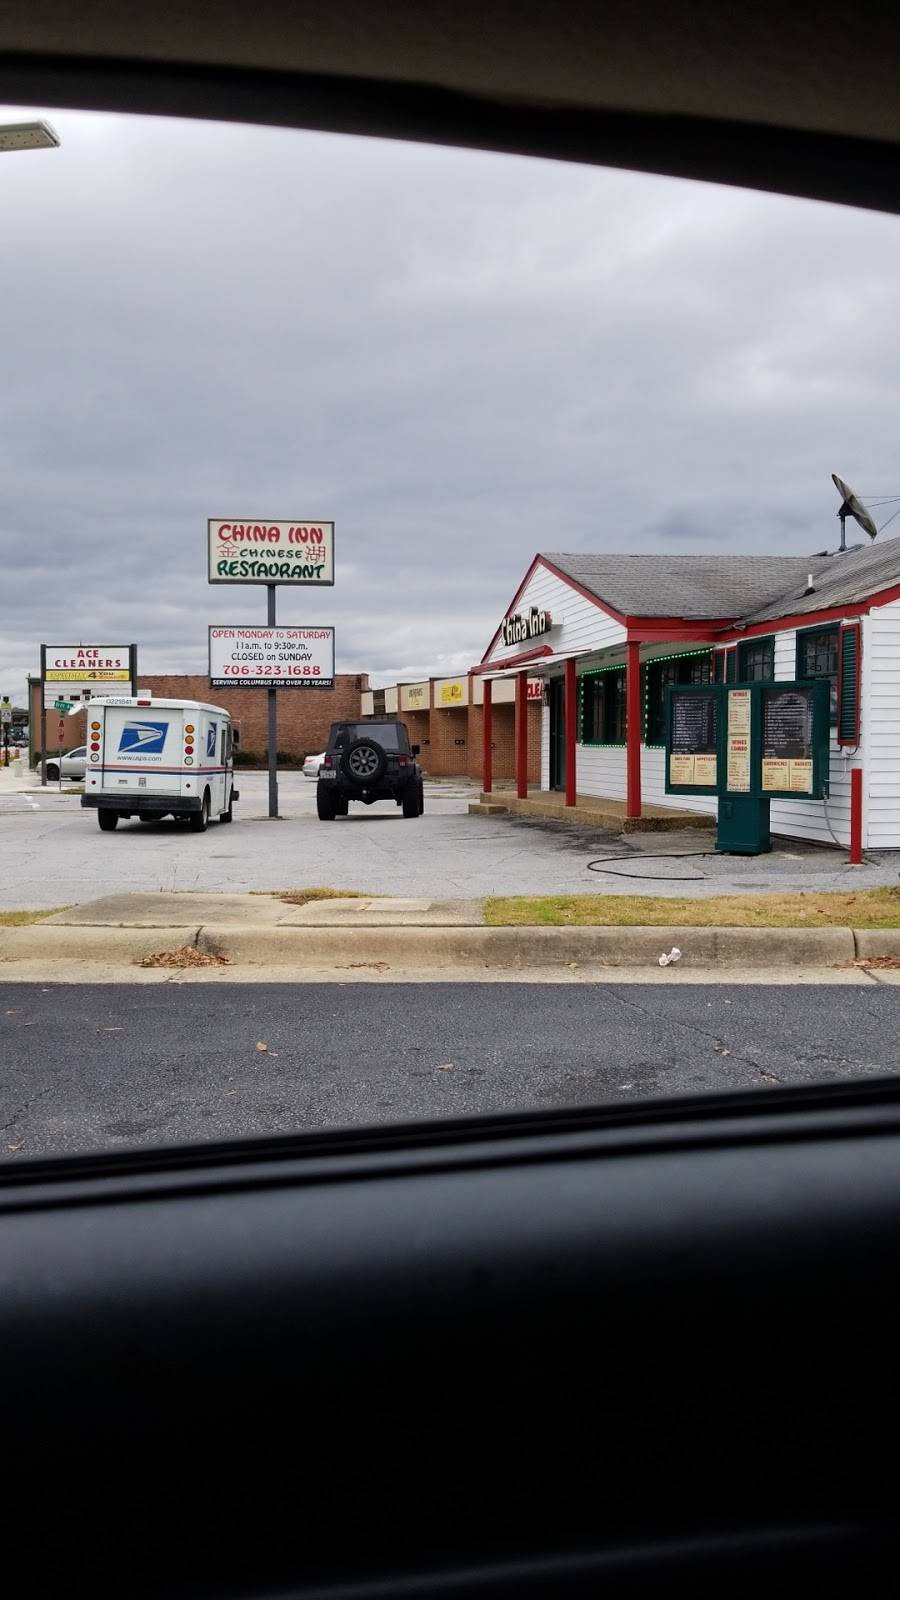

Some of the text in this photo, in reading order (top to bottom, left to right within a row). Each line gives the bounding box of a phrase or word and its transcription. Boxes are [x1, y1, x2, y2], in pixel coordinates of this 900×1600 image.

[218, 524, 323, 544] CHINA INN
[216, 540, 240, 558] 金
[239, 548, 303, 558] CHINESE
[217, 560, 325, 578] RESTAURANT
[501, 606, 548, 646] China Inn
[211, 629, 235, 638] OPEN
[237, 630, 273, 638] MONDAY
[287, 630, 331, 639] SATURDAY
[264, 641, 272, 650] to
[273, 641, 308, 651] 9:30p.m.
[77, 649, 99, 658] ACE
[231, 652, 265, 661] CLOSED
[278, 652, 313, 661] SUNDAY
[54, 659, 122, 668] CLEANERS
[87, 671, 97, 679] 4
[223, 665, 321, 675] 706-323-1688
[527, 683, 543, 698] CLE
